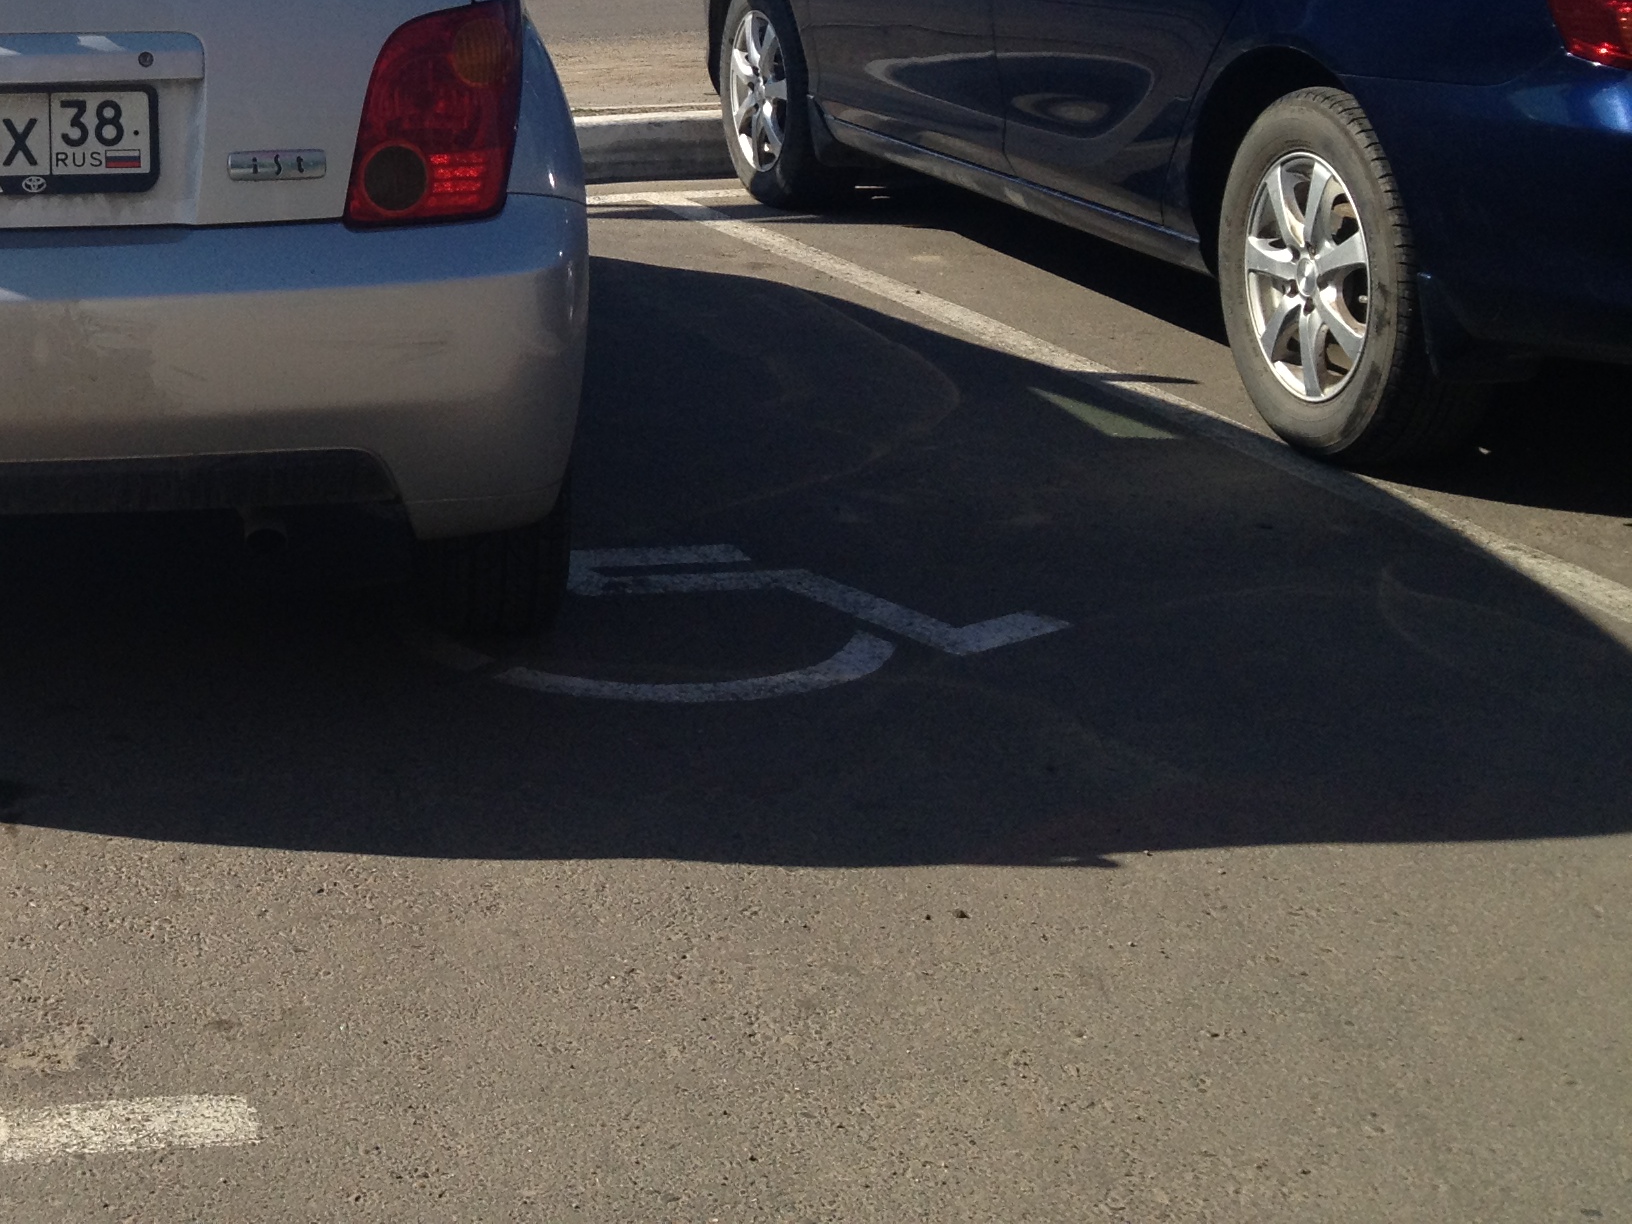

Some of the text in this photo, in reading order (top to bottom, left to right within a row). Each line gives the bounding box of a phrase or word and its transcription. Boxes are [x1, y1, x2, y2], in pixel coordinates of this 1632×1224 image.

[59, 99, 125, 147] 38
[55, 151, 103, 168] RUS
[251, 153, 305, 176] ist
